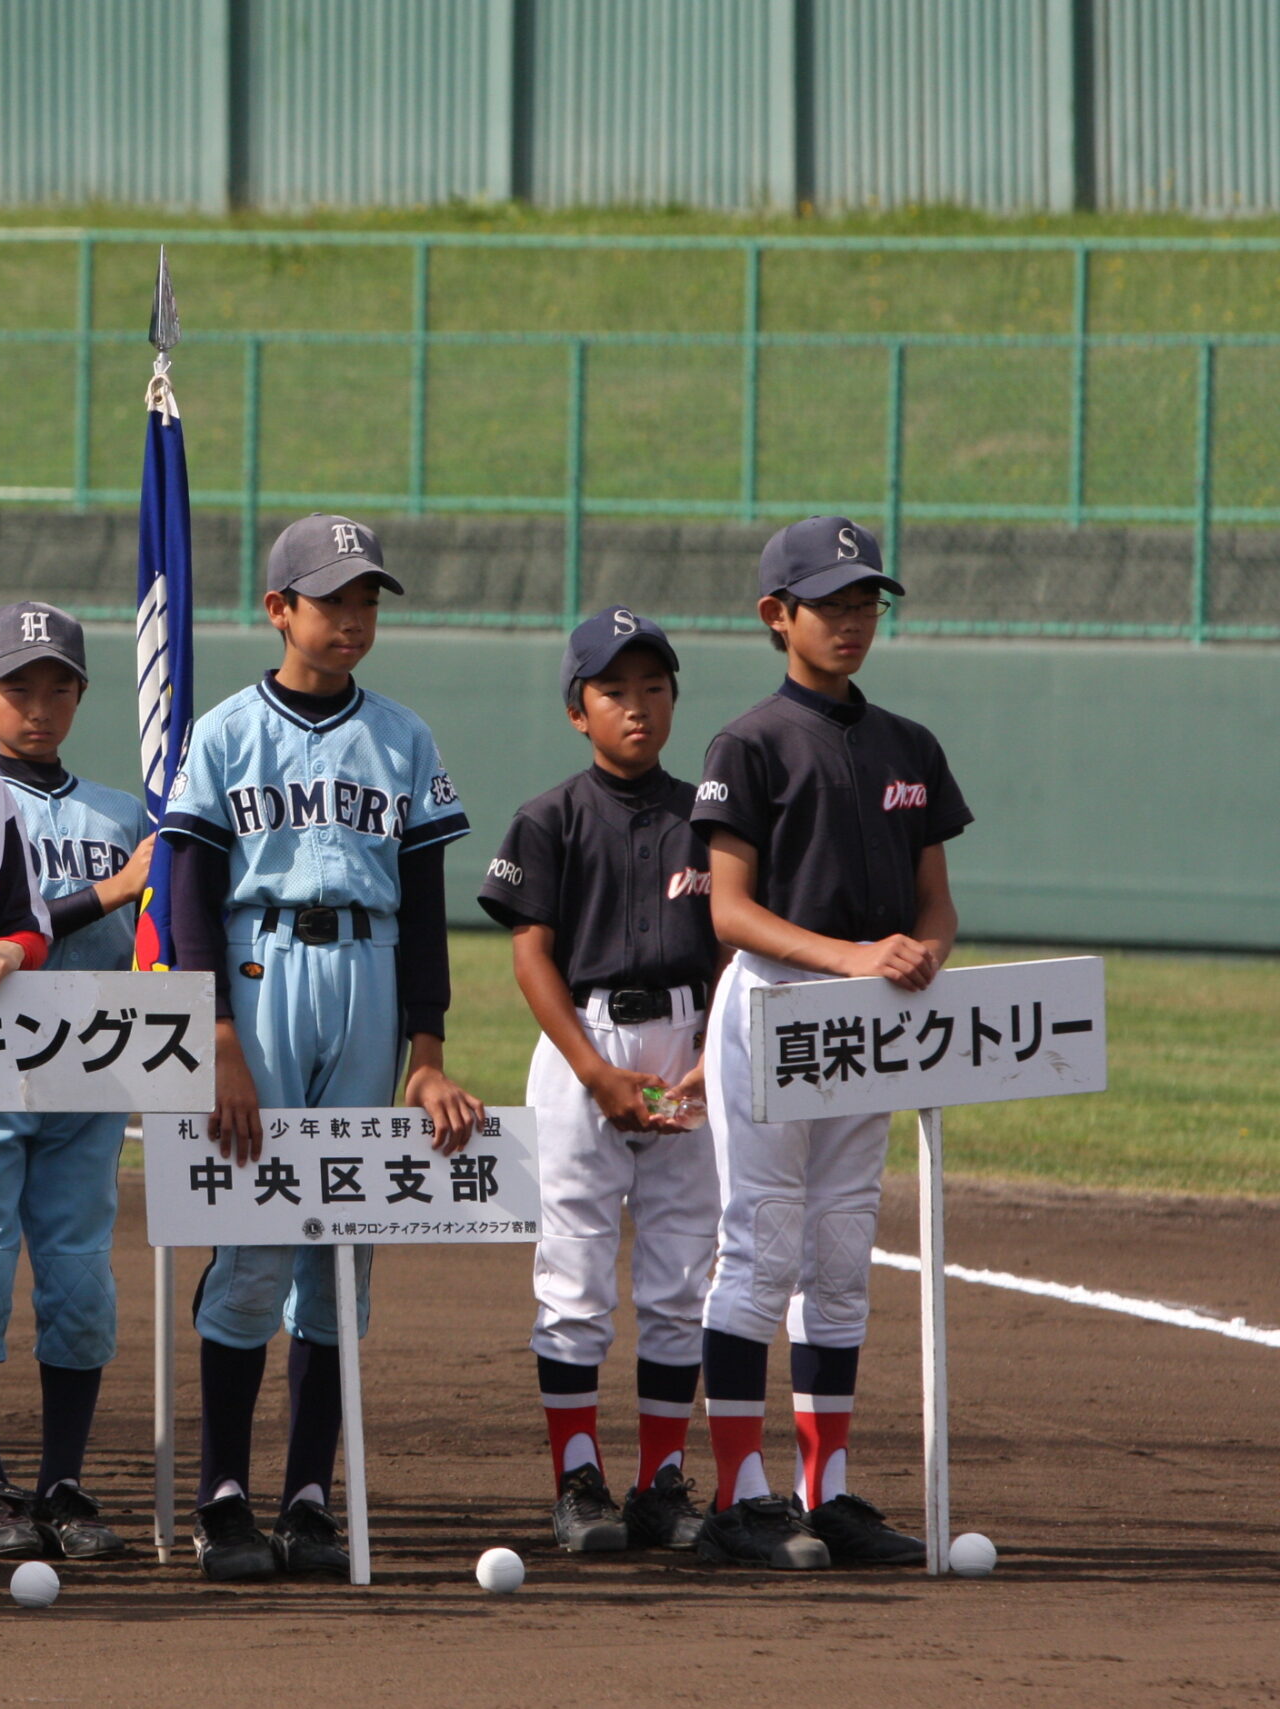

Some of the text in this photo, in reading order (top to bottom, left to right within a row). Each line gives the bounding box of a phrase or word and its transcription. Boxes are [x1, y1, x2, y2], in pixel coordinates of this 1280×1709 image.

[331, 524, 364, 554] H
[837, 527, 860, 560] S
[21, 612, 52, 642] H
[614, 609, 637, 637] S
[775, 1001, 1093, 1088] 真栄ビクトリー
[189, 1154, 499, 1206] 中央区支部
